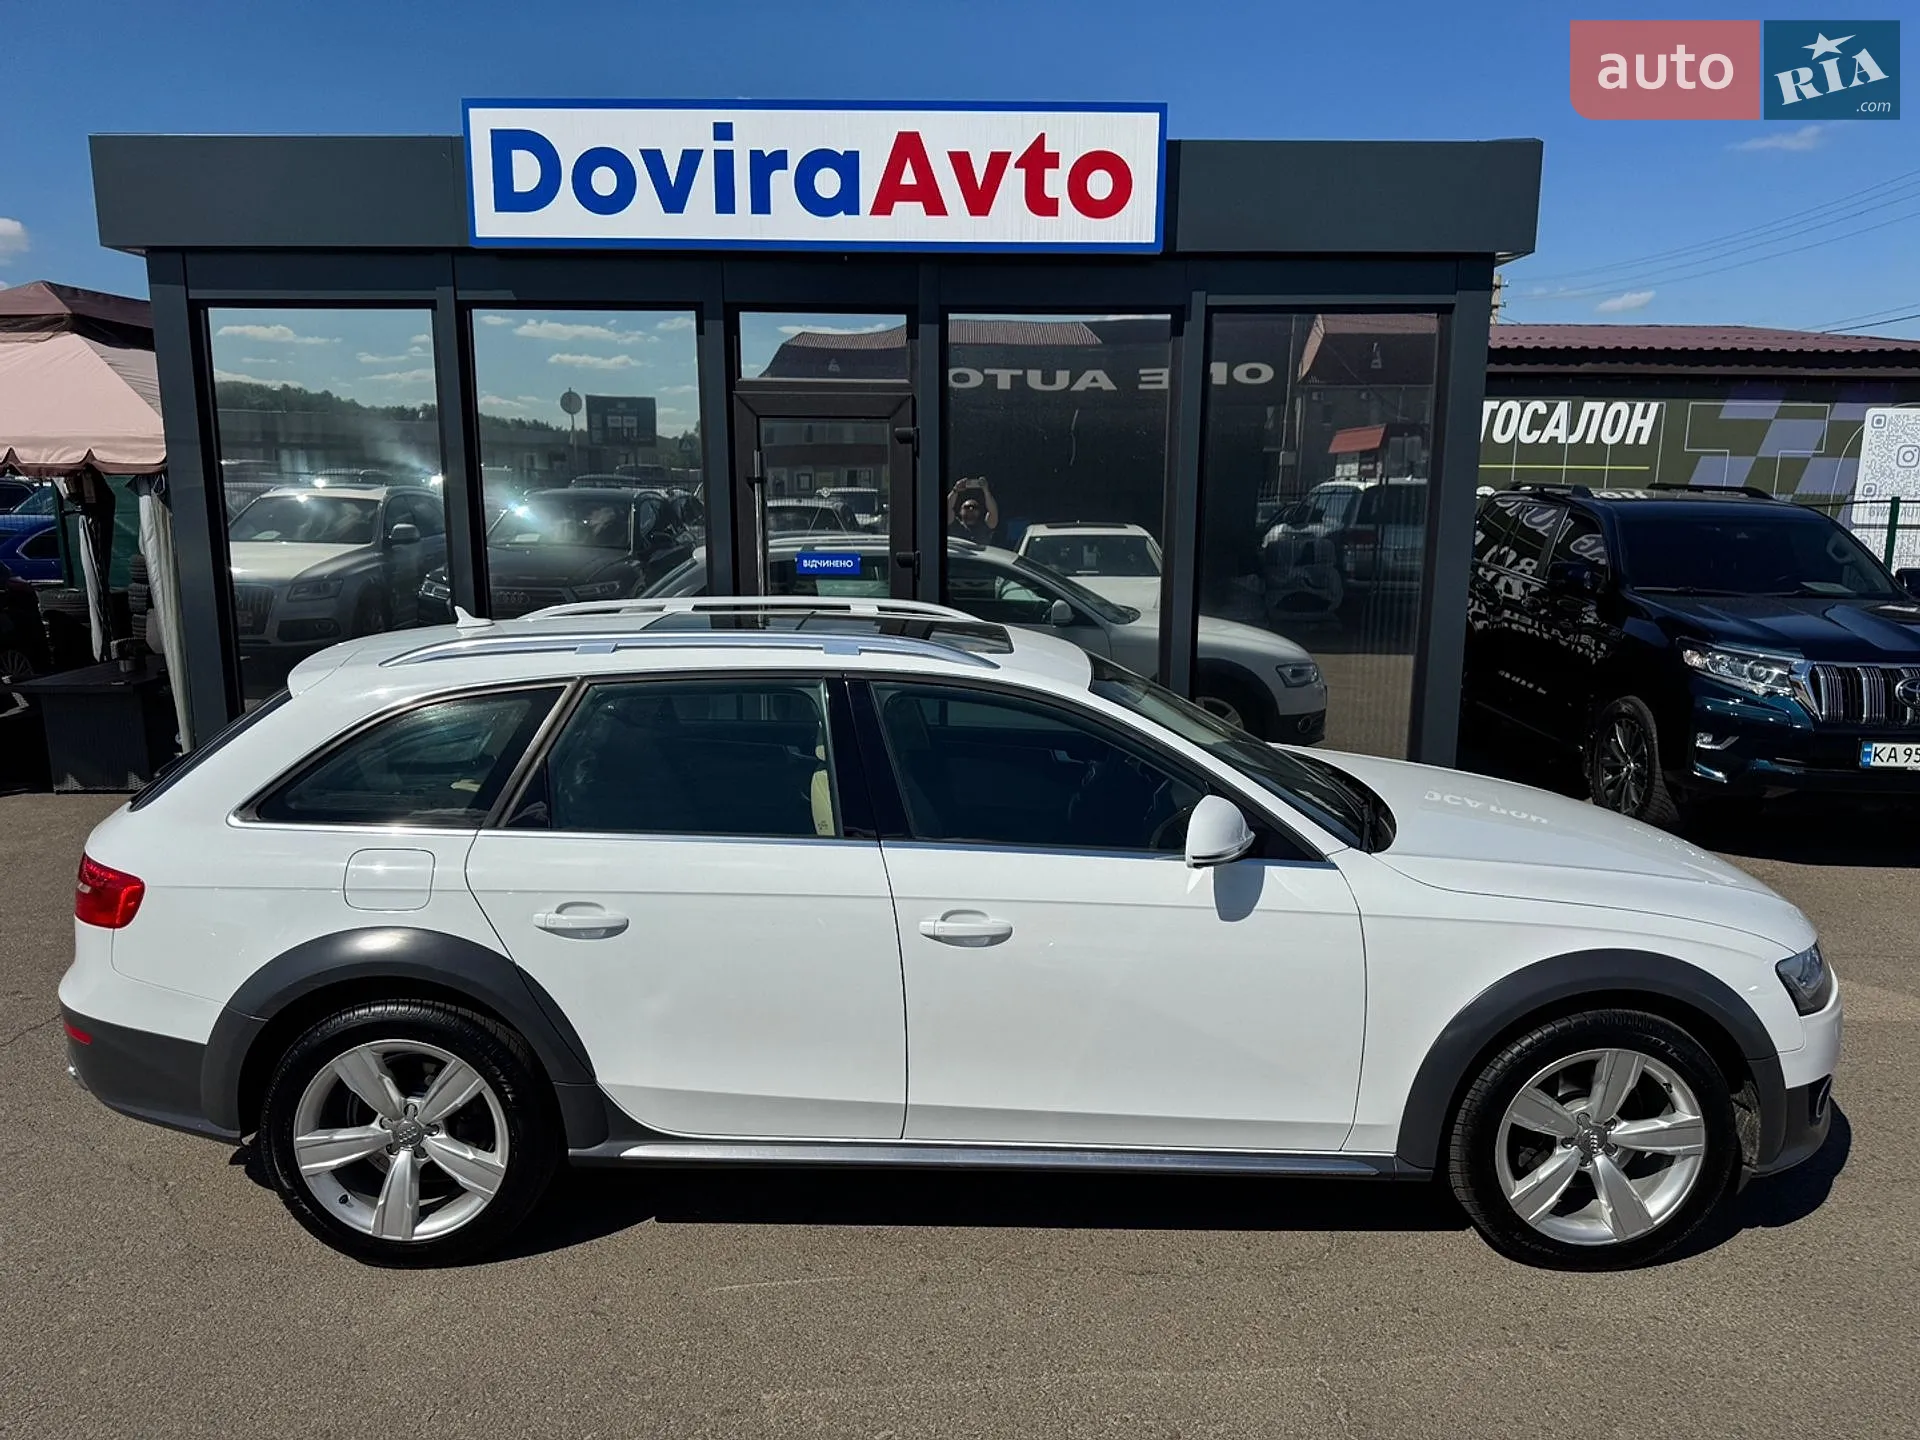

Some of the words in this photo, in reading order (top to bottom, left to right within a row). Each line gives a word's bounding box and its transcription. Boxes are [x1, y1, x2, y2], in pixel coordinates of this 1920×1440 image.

[489, 121, 1133, 219] DoviraAvto
[802, 559, 854, 569] ВІДЧИНЕНО
[1873, 747, 1898, 763] KA
